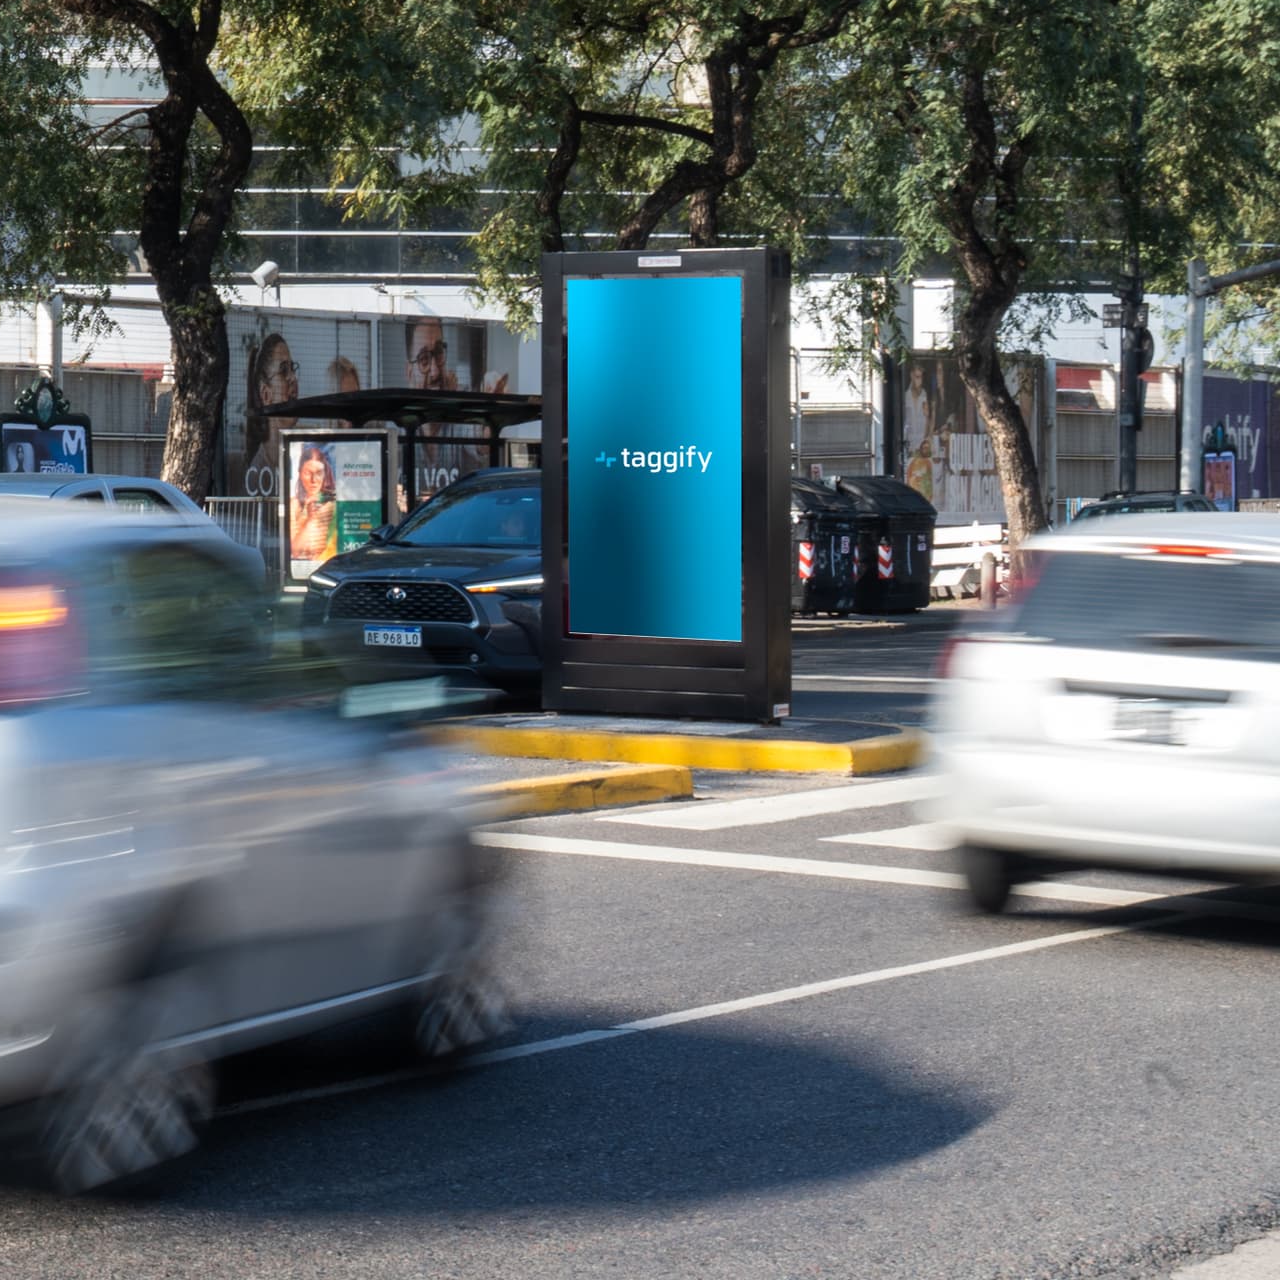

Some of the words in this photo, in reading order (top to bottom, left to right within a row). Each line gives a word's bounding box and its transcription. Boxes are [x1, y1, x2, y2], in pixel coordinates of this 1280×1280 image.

[620, 445, 713, 473] taggify
[367, 631, 380, 644] AE
[383, 632, 402, 645] 968
